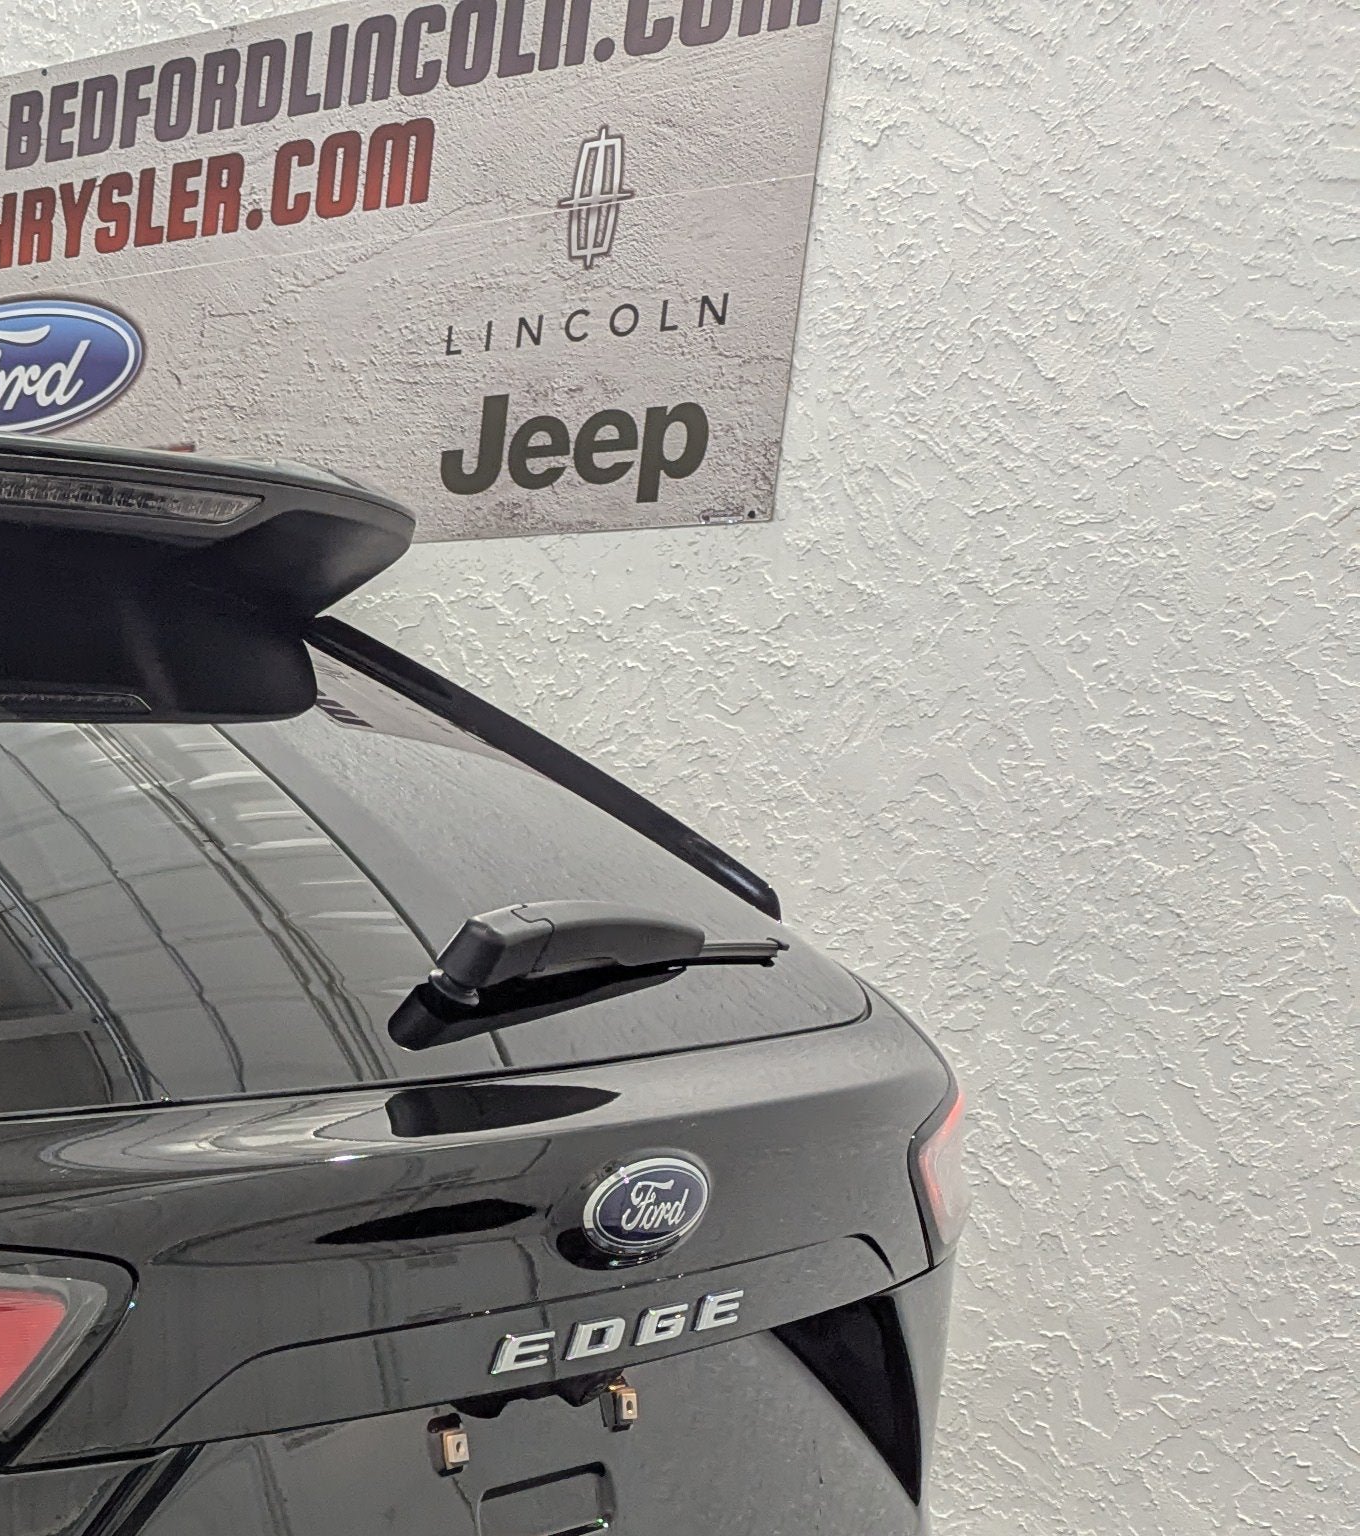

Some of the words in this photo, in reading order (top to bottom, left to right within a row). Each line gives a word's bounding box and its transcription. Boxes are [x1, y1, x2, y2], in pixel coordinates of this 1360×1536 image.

[445, 292, 729, 356] LINCOLN
[440, 393, 710, 503] Jeep
[621, 1178, 690, 1231] Ford
[490, 1289, 745, 1375] EDGE
